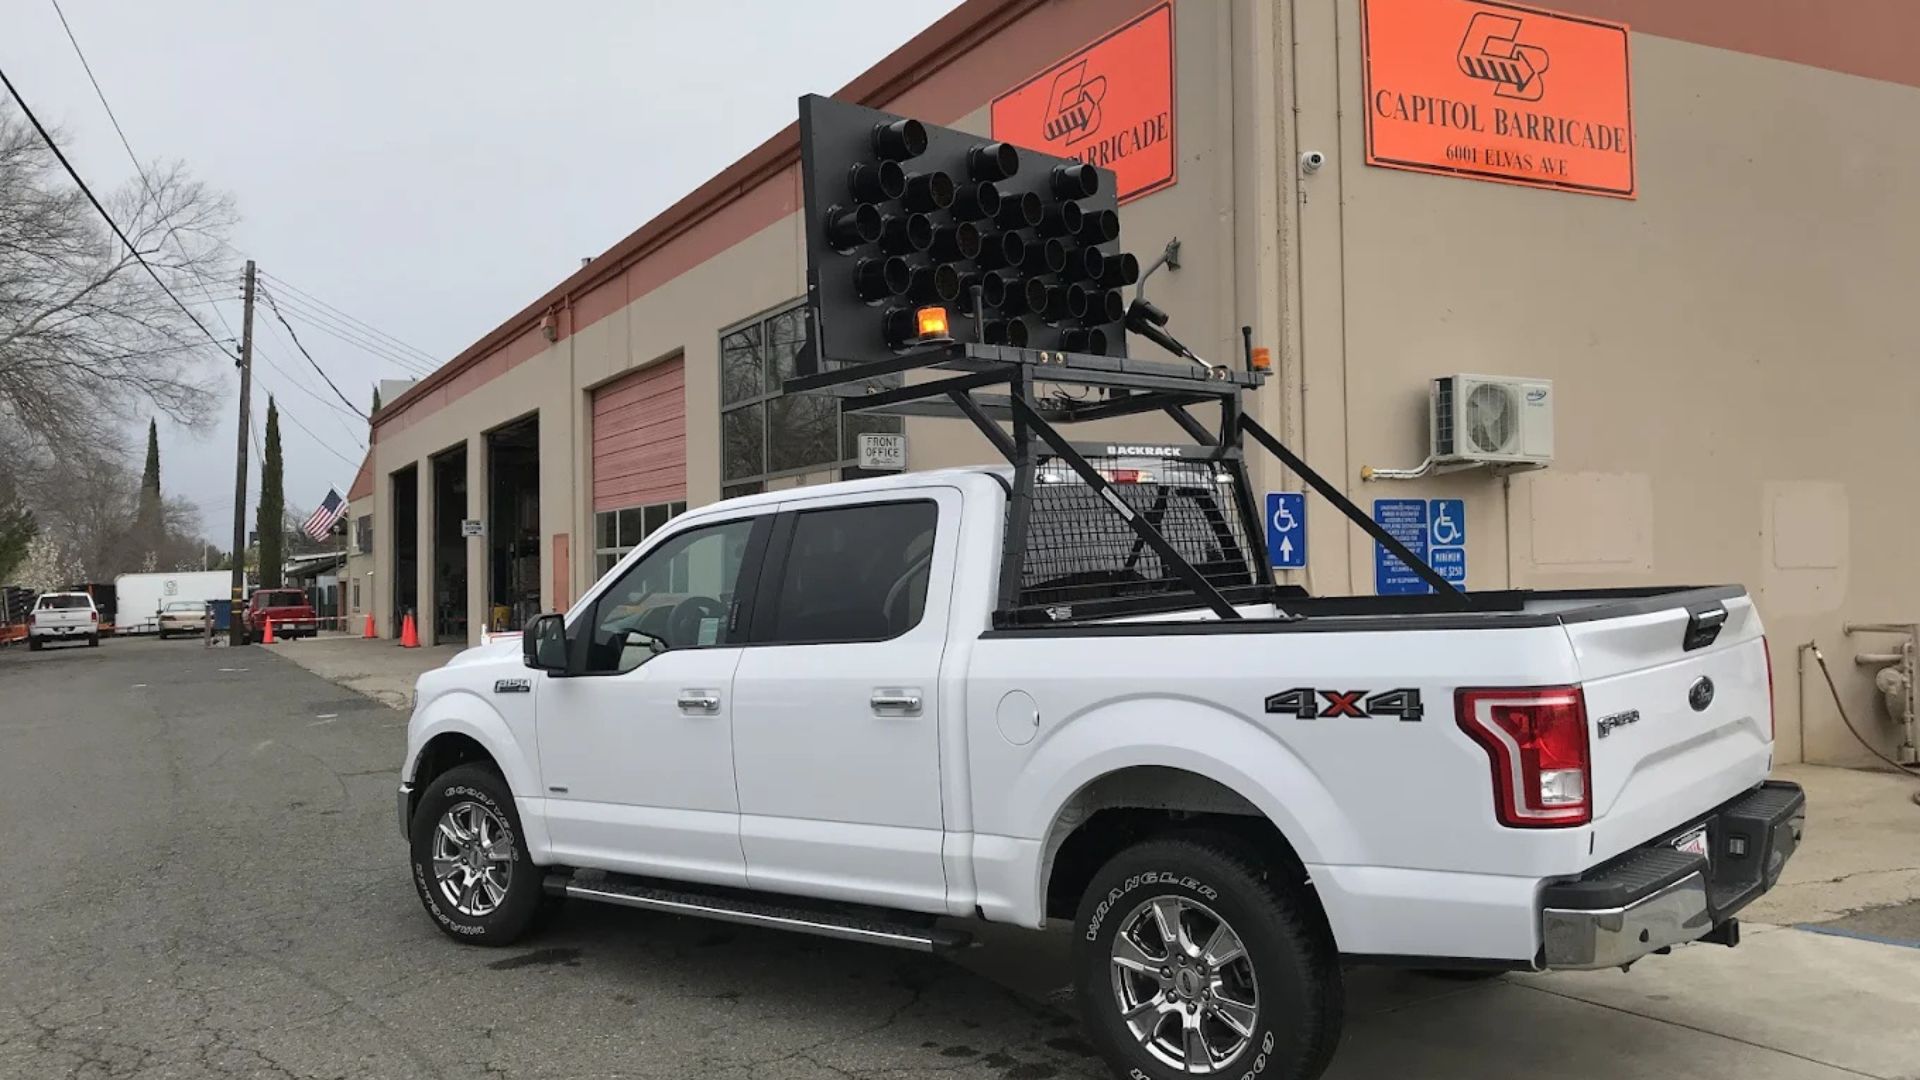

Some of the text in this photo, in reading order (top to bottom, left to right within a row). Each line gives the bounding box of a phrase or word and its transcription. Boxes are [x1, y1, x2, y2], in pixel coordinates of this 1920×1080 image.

[1376, 89, 1626, 153] CAPITOL BARRICADE
[1068, 112, 1168, 167] RRICADE
[1446, 143, 1568, 177] 6001 ELVAS AVE
[866, 446, 900, 458] OFFICE
[867, 436, 898, 447] FRONT
[1107, 445, 1181, 456] BACKRACK
[1086, 871, 1218, 941] WRANGLER
